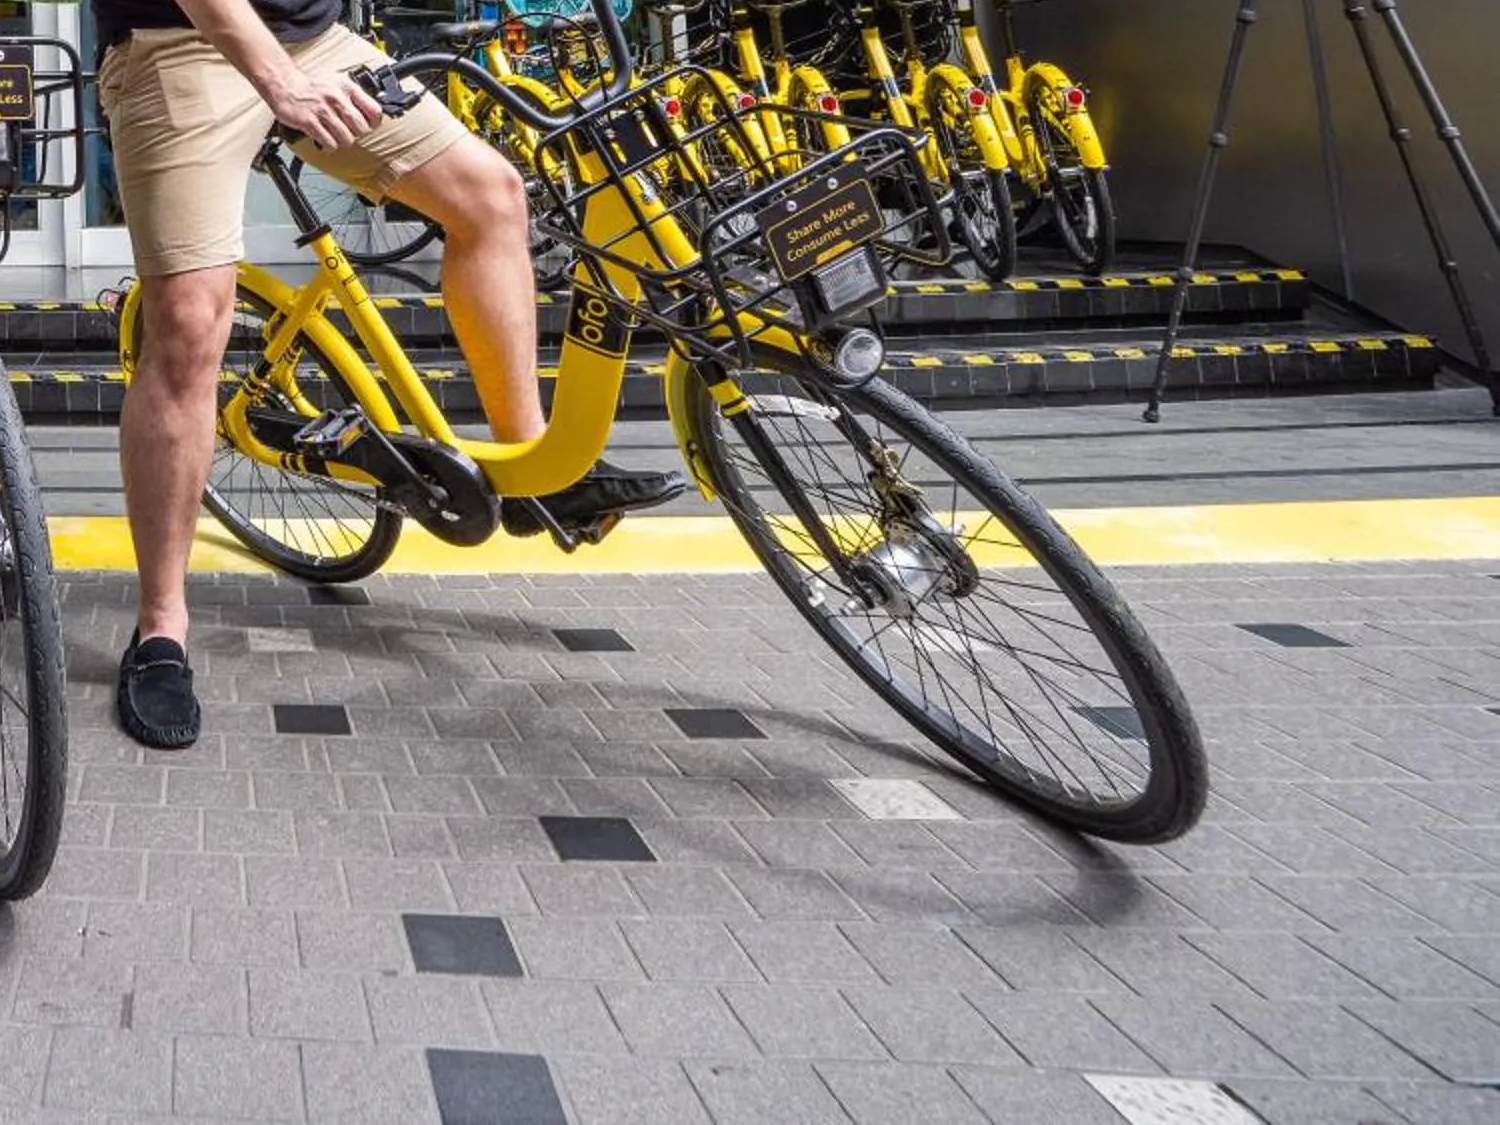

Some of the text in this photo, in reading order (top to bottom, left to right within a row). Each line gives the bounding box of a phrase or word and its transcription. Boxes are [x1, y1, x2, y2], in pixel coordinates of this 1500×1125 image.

[0, 94, 23, 105] Less
[787, 201, 856, 243] Share More
[787, 213, 870, 261] Consume Less
